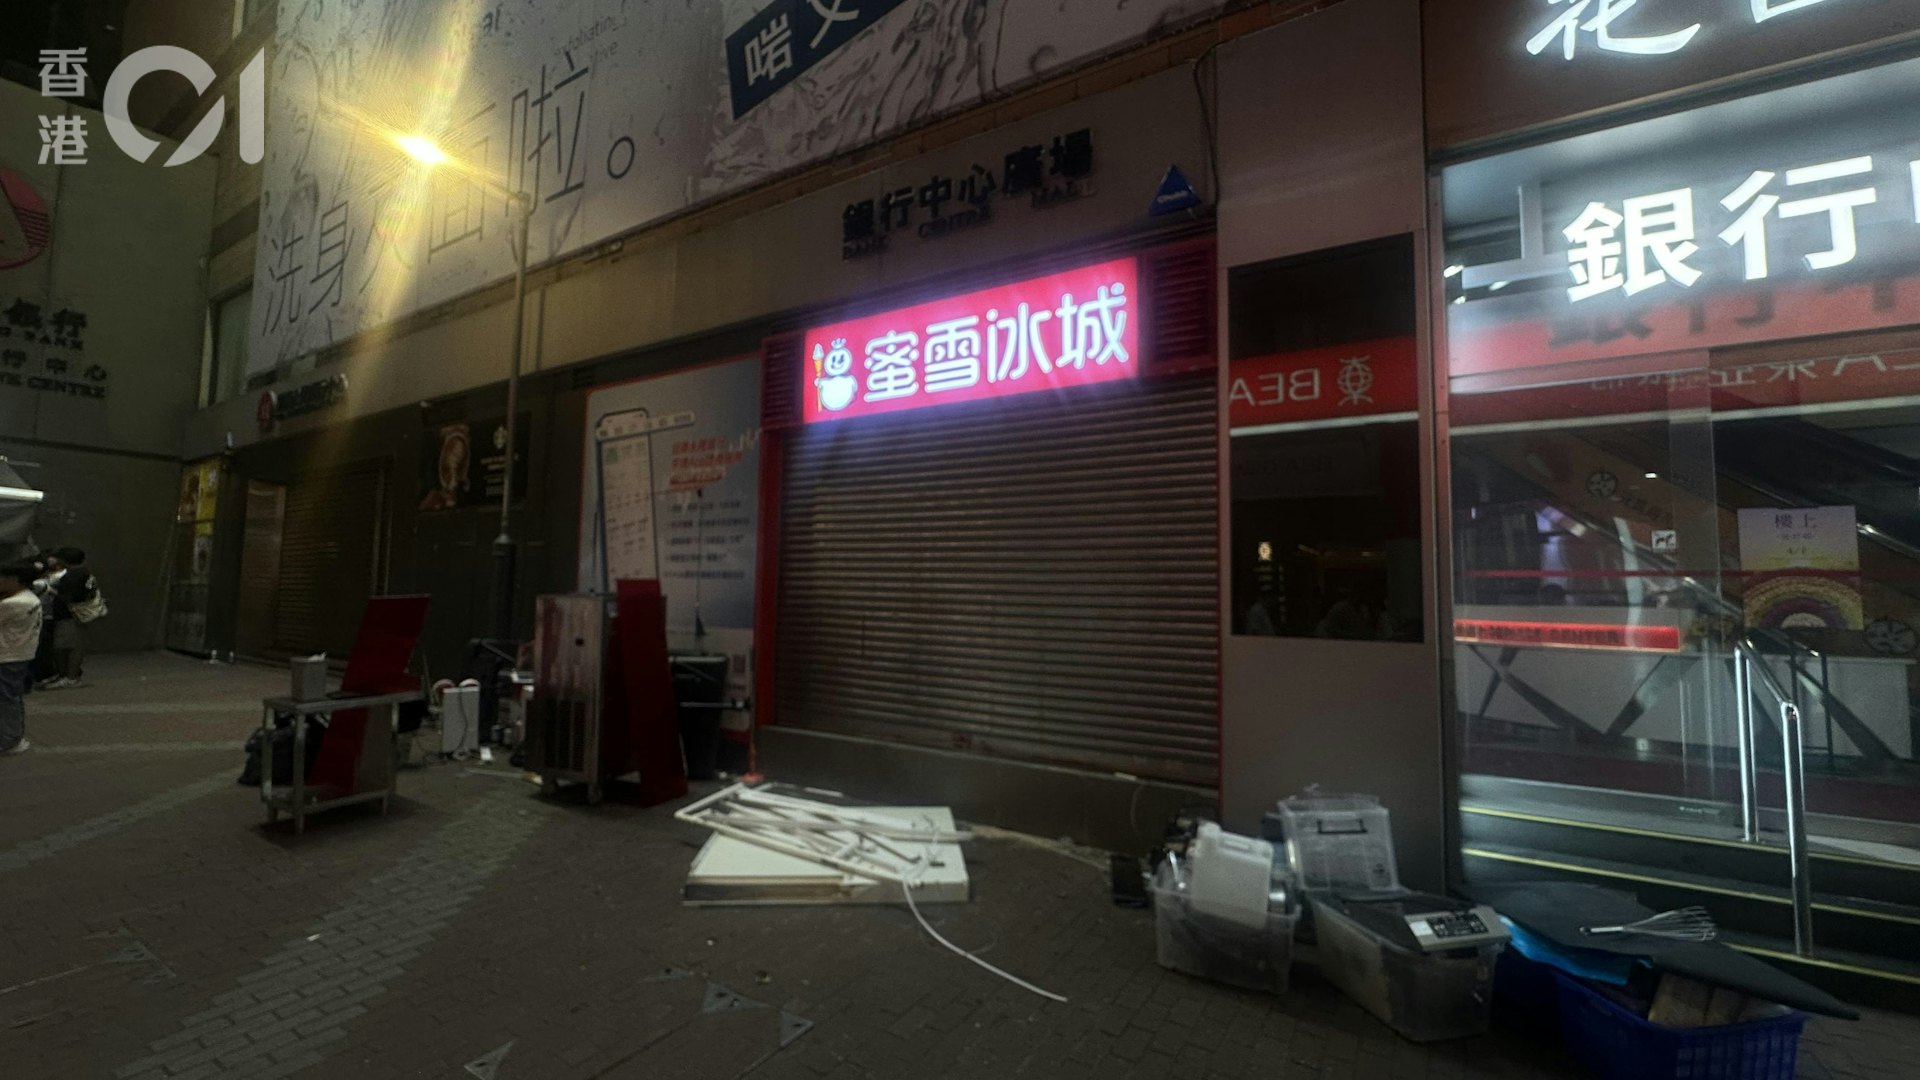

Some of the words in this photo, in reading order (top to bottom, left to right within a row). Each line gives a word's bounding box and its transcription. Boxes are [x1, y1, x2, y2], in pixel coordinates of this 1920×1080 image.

[1561, 154, 1920, 305] 銀行
[863, 281, 1127, 403] 蜜雪冰城
